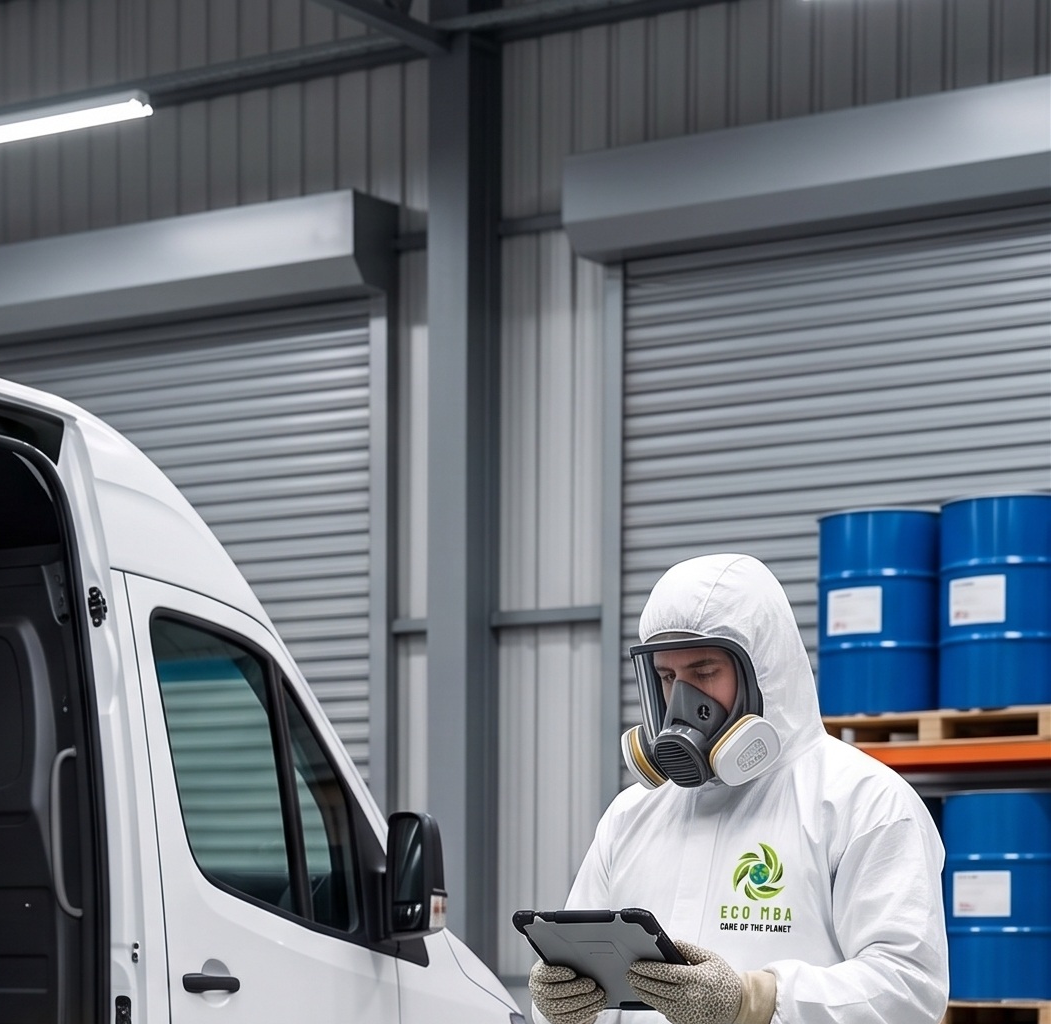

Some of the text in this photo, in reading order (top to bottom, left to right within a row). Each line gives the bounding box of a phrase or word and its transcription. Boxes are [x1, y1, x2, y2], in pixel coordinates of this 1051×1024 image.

[721, 906, 792, 921] ECO MBA
[751, 924, 763, 932] THE
